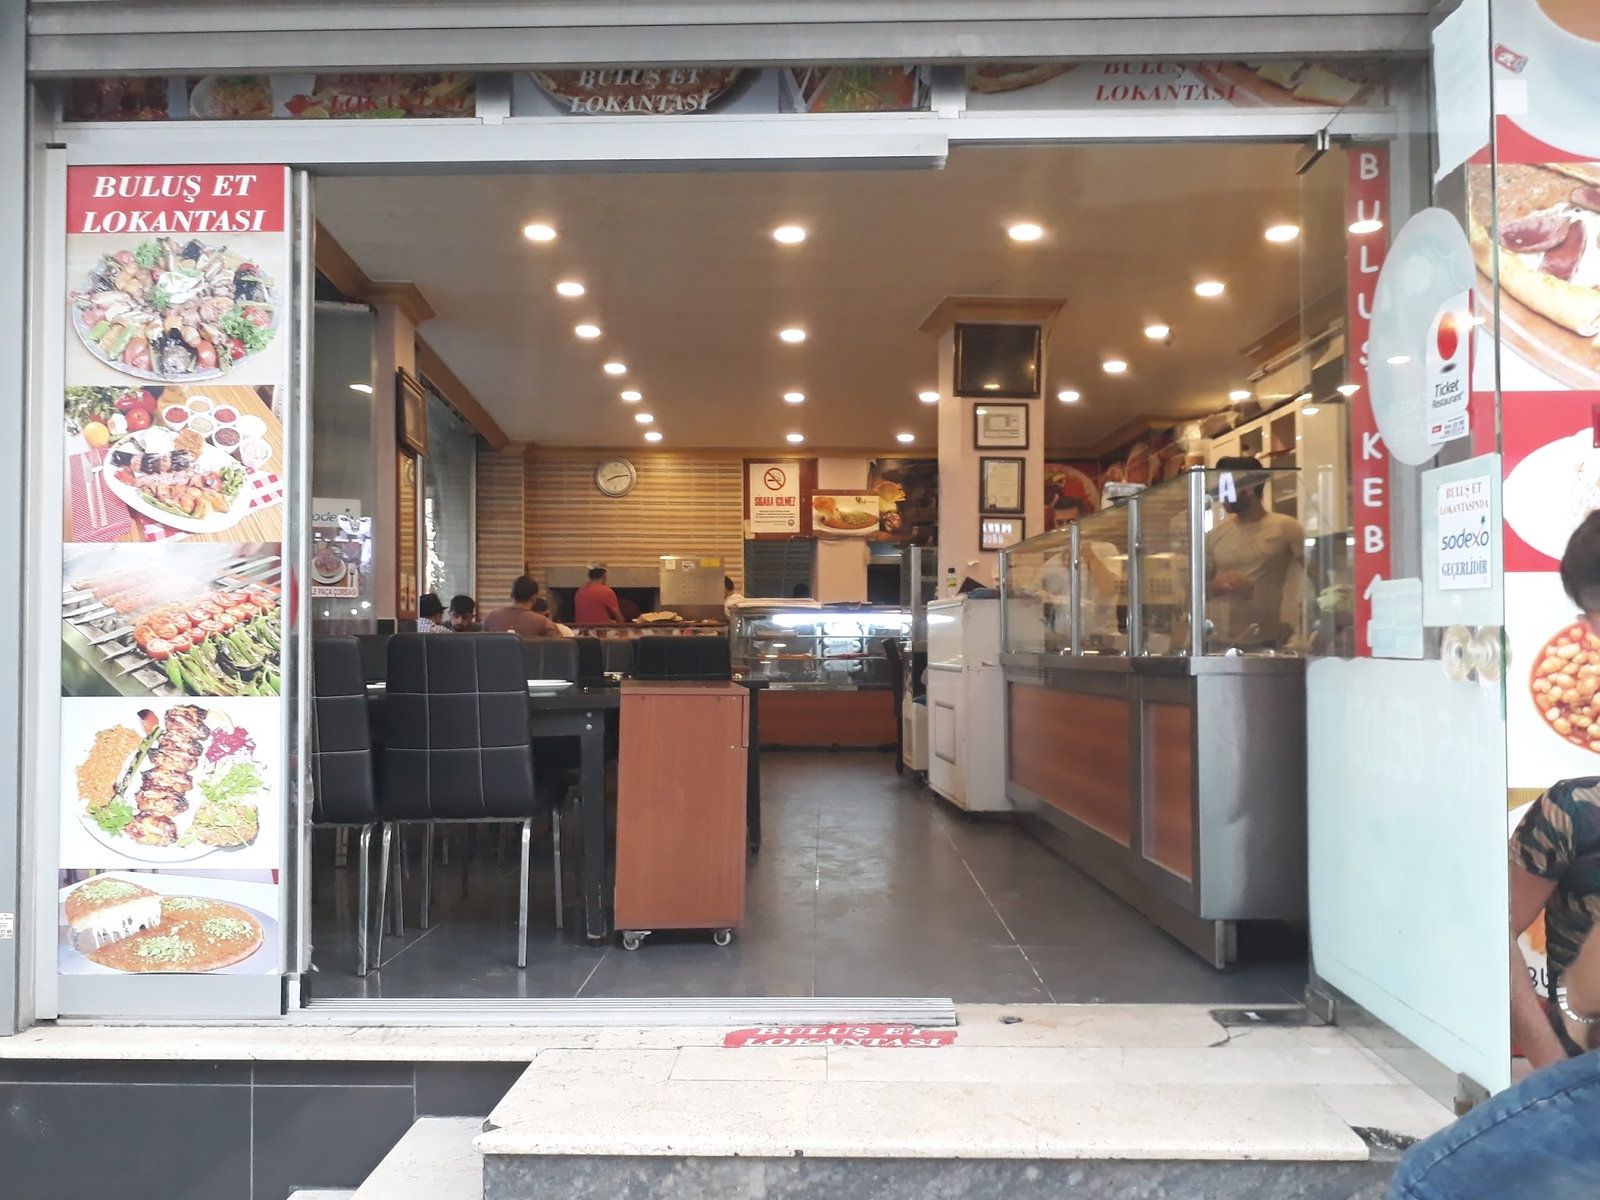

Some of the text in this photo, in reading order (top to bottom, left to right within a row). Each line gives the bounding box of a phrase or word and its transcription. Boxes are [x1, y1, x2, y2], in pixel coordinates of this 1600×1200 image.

[578, 68, 703, 90] BULUŞ ET
[568, 89, 711, 114] LOKANTASI
[1095, 84, 1237, 101] LOKANTASI
[92, 174, 257, 203] BULUŞ ET
[80, 209, 267, 233] LOKANTASI
[1434, 379, 1460, 398] Ticket
[1445, 482, 1482, 499] BULUŞ ET
[1440, 499, 1489, 516] LOKANTASINDA
[1362, 431, 1385, 648] KEB
[1441, 527, 1490, 551] sodexo
[1441, 556, 1488, 581] GEÇERLİDİR
[743, 1037, 944, 1048] LOKANTASI
[755, 1026, 923, 1038] BULUŞ ET
